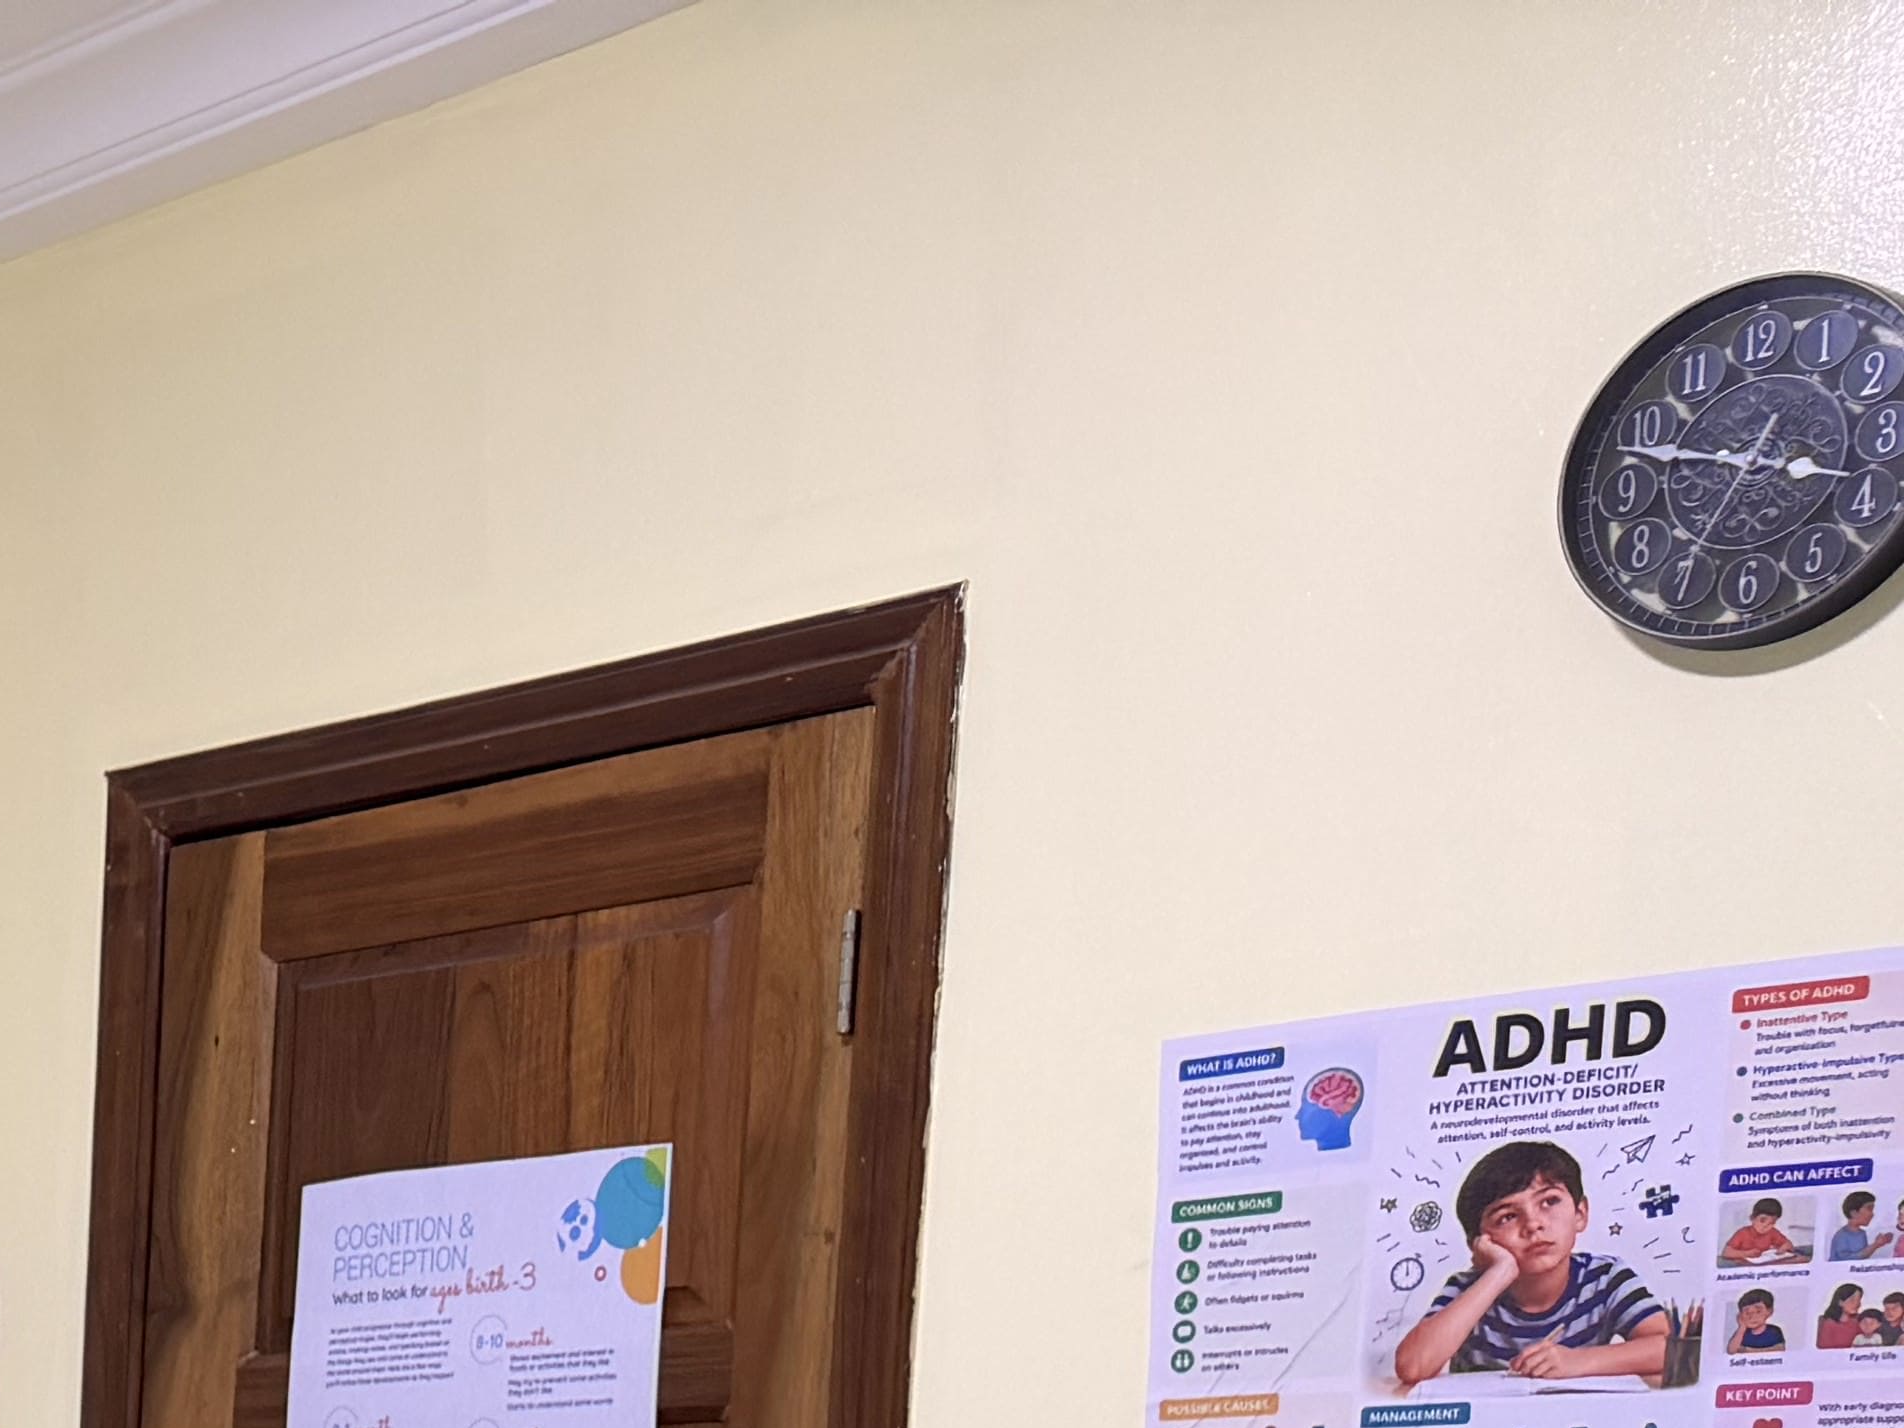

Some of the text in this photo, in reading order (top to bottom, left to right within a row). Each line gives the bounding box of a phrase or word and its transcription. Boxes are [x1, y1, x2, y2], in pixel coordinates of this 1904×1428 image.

[1743, 319, 1776, 362] 12
[1818, 320, 1830, 362] 1
[1682, 349, 1706, 394] 11
[1860, 352, 1885, 397] 2
[1633, 407, 1662, 448] 10
[1877, 408, 1897, 452] 3
[1618, 468, 1636, 512] 9
[1851, 475, 1876, 517] 4
[1632, 524, 1650, 567] 8
[1804, 534, 1823, 572] 5
[1674, 559, 1694, 601] 7
[1740, 560, 1758, 603] 6
[1743, 983, 1855, 1007] TYPES OF ADHD
[1757, 1010, 1848, 1028] Inattentive Type
[1432, 999, 1666, 1078] ADHD
[1186, 1052, 1277, 1076] WHAT IS ADHD?
[1456, 1063, 1638, 1096] ATTENTION-DEFICIT/
[1429, 1079, 1666, 1116] HYPERACTIVITY DISORDER
[1437, 1115, 1651, 1144] attention, self-control, and activity levels.
[1729, 1165, 1861, 1186] ADHD CAN AFFECT
[1179, 1197, 1273, 1218] COMMON SIGNS
[334, 1212, 475, 1252] COGNITION &
[1209, 1219, 1311, 1237] Trouble paying attention
[333, 1245, 468, 1282] PERCEPTION
[366, 1290, 379, 1303] to
[381, 1286, 407, 1302] look
[410, 1284, 428, 1299] for
[429, 1282, 461, 1313] ages
[465, 1265, 509, 1294] birth
[475, 1326, 552, 1350] 8-10 months
[1849, 1351, 1897, 1363] Family life
[1726, 1387, 1800, 1401] KEY POINT
[1369, 1408, 1460, 1423] MANAGEMENT
